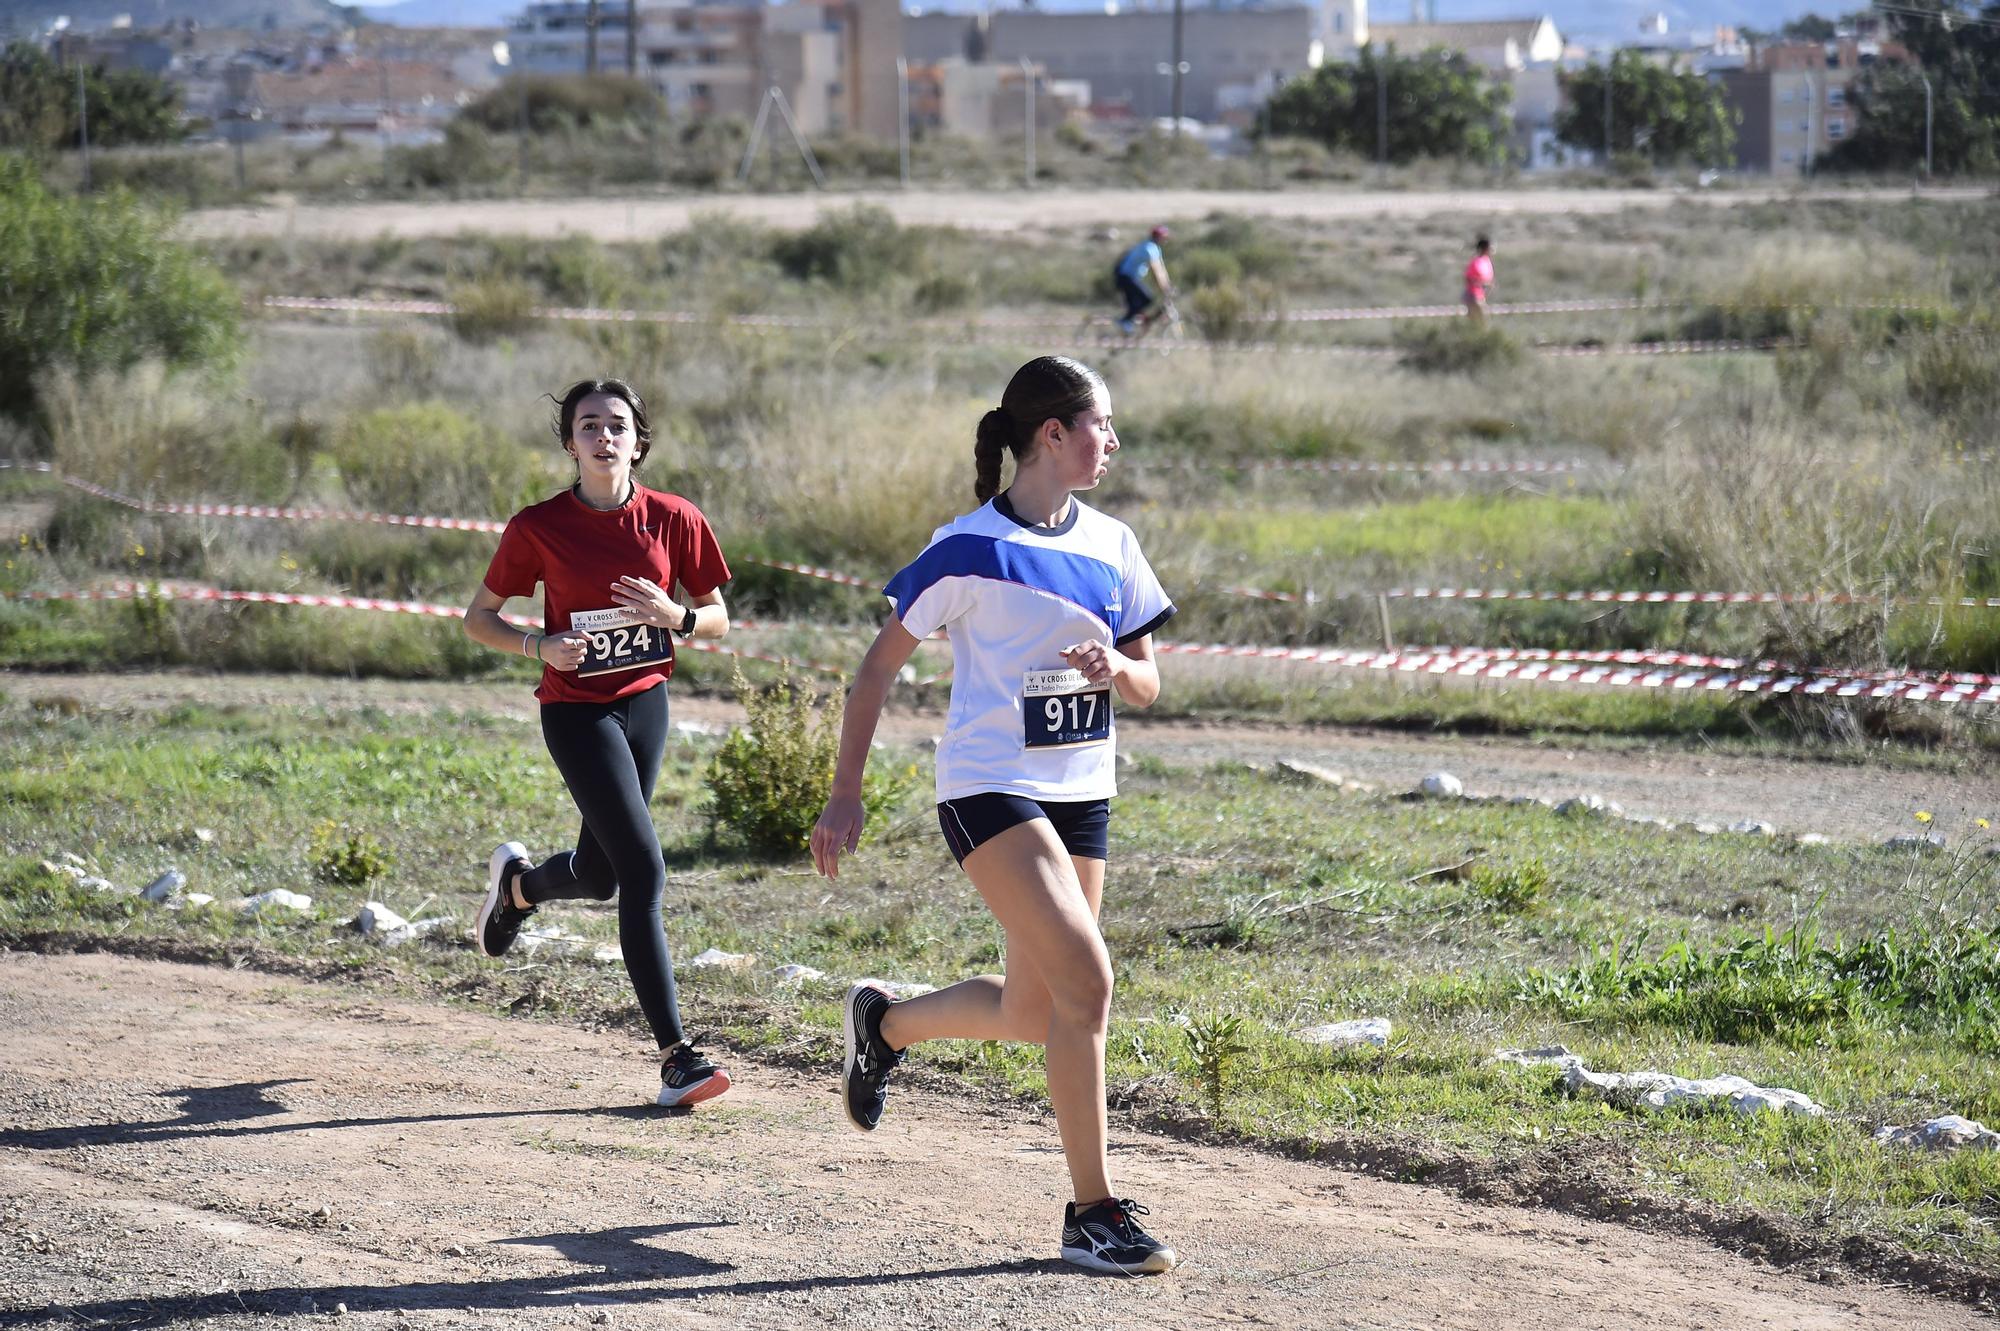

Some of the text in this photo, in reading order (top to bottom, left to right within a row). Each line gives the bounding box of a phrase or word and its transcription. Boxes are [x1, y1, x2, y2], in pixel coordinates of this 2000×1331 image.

[593, 612, 613, 621] CROSS
[592, 625, 652, 661] 924
[1047, 674, 1068, 683] CROSS
[1044, 694, 1097, 732] 917
